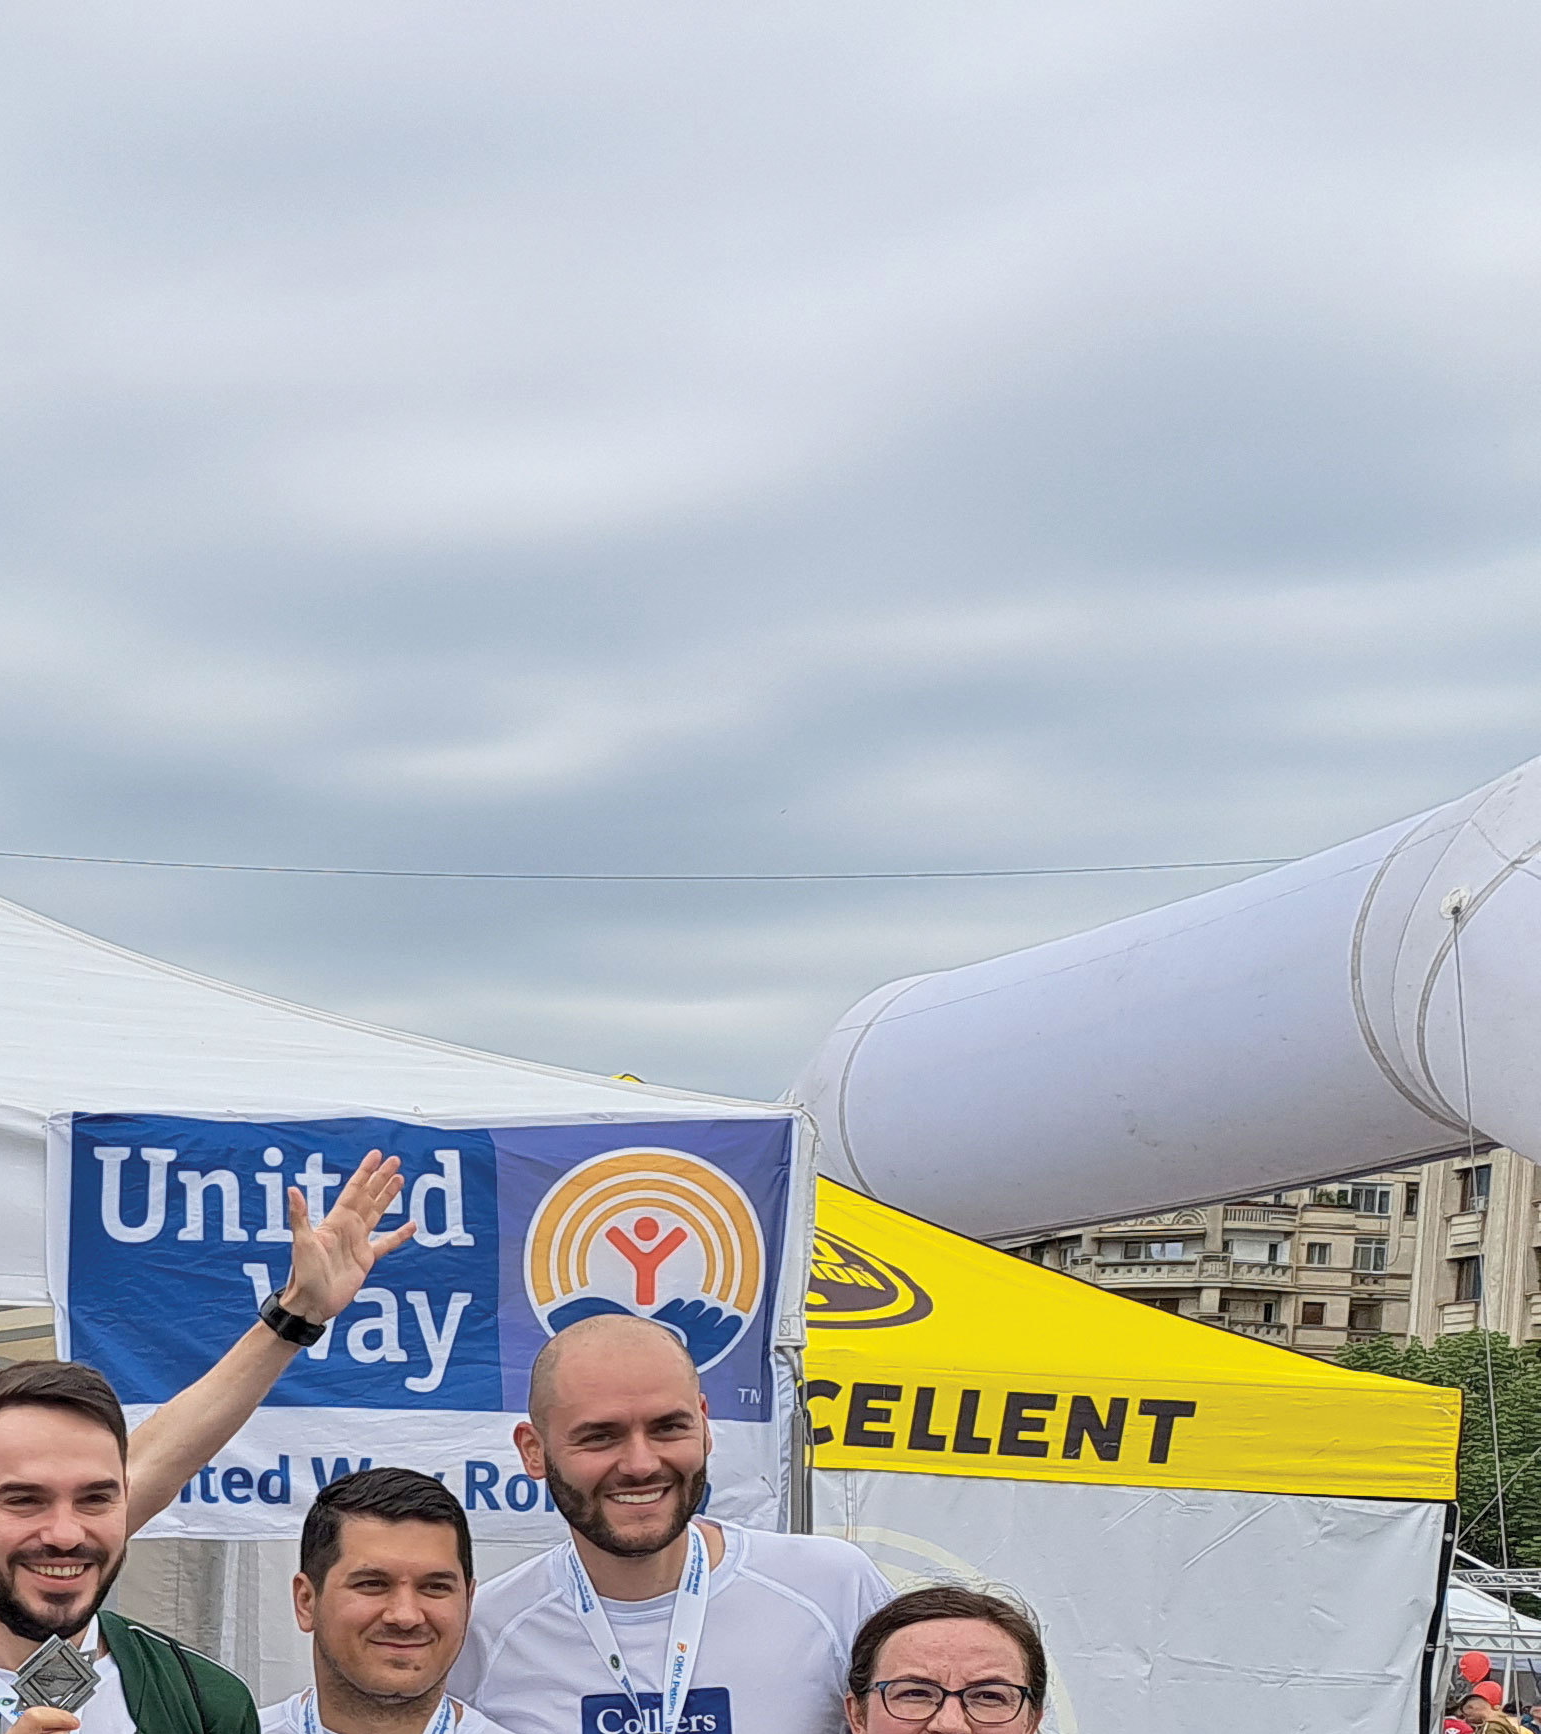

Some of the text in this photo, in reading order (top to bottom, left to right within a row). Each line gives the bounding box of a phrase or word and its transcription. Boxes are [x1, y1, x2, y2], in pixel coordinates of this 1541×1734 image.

[94, 1147, 475, 1247] Unitd
[667, 1655, 685, 1715] OMV Petrom
